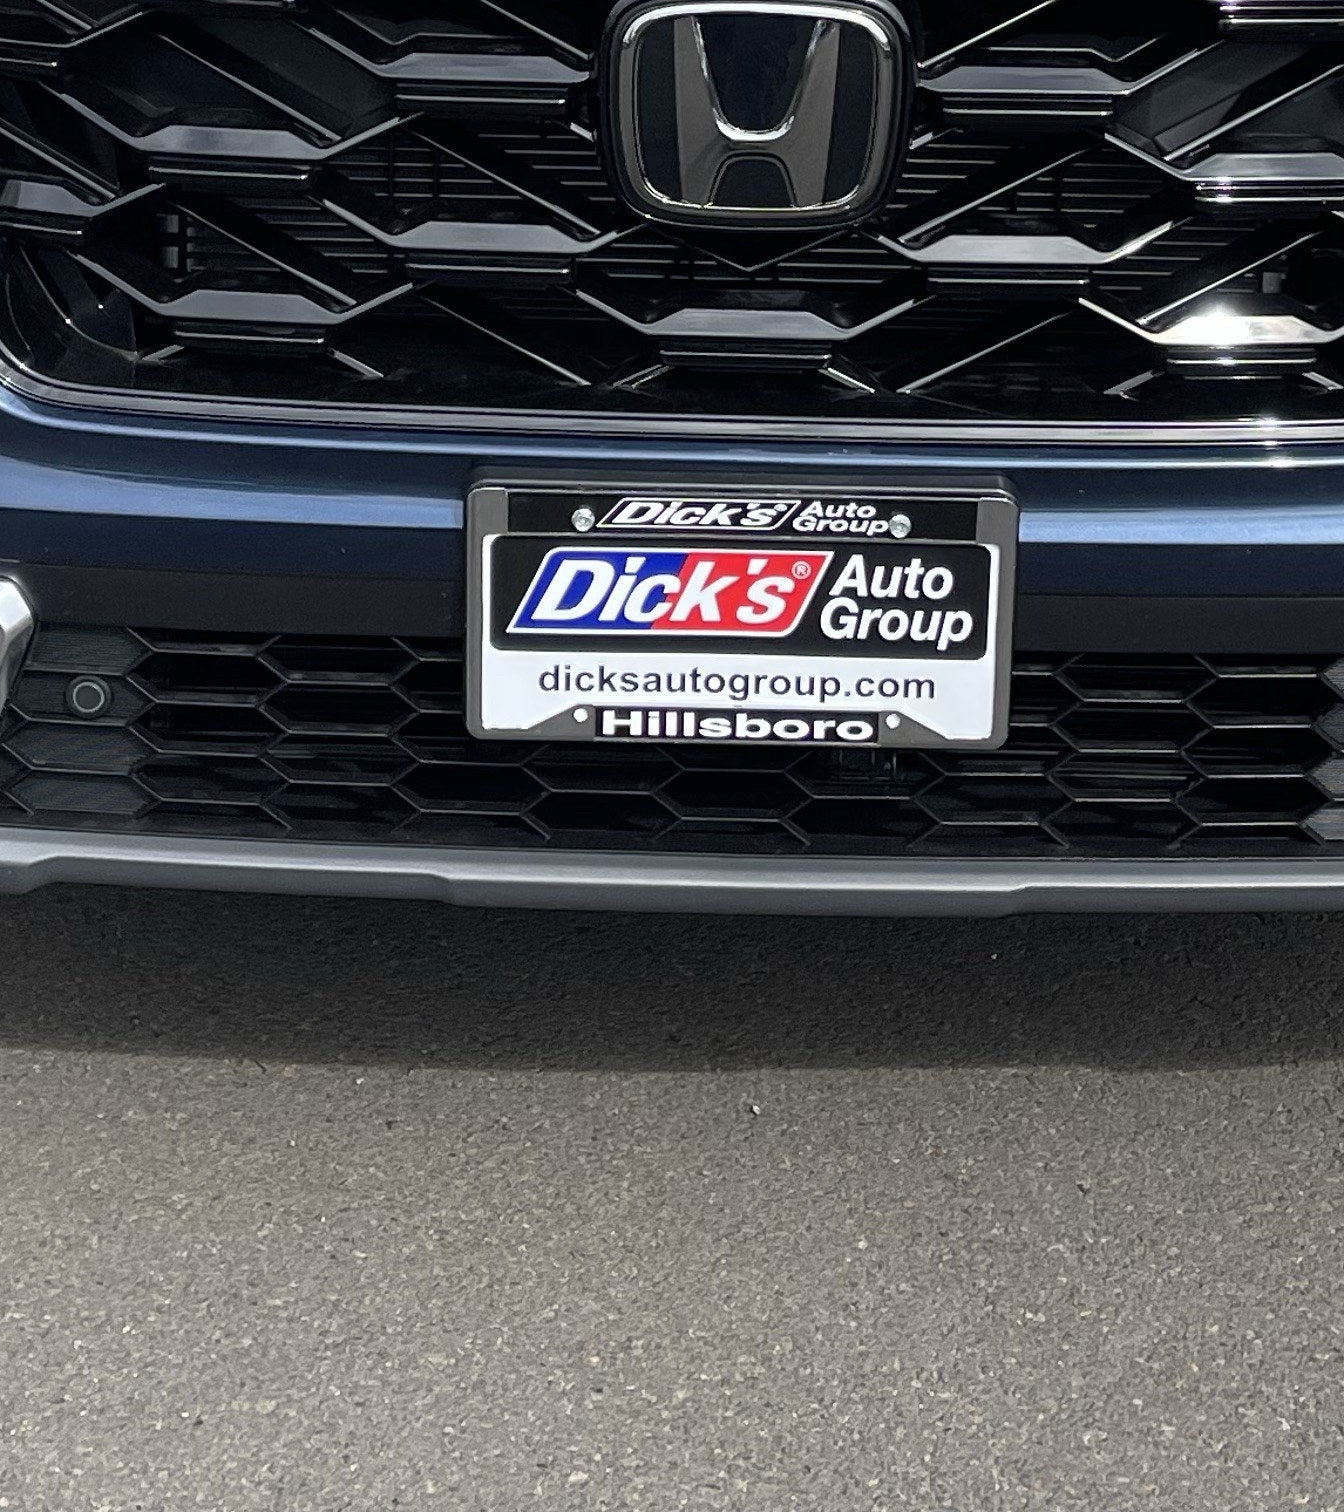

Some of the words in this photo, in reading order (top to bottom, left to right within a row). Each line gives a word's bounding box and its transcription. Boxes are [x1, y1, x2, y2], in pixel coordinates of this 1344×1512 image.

[792, 514, 889, 536] Group
[799, 500, 877, 519] Auto
[531, 556, 794, 625] Dick's
[829, 553, 955, 600] Auto
[819, 596, 973, 651] Group
[538, 664, 936, 702] dicksautogroup.com
[601, 710, 874, 740] Hillsboro
